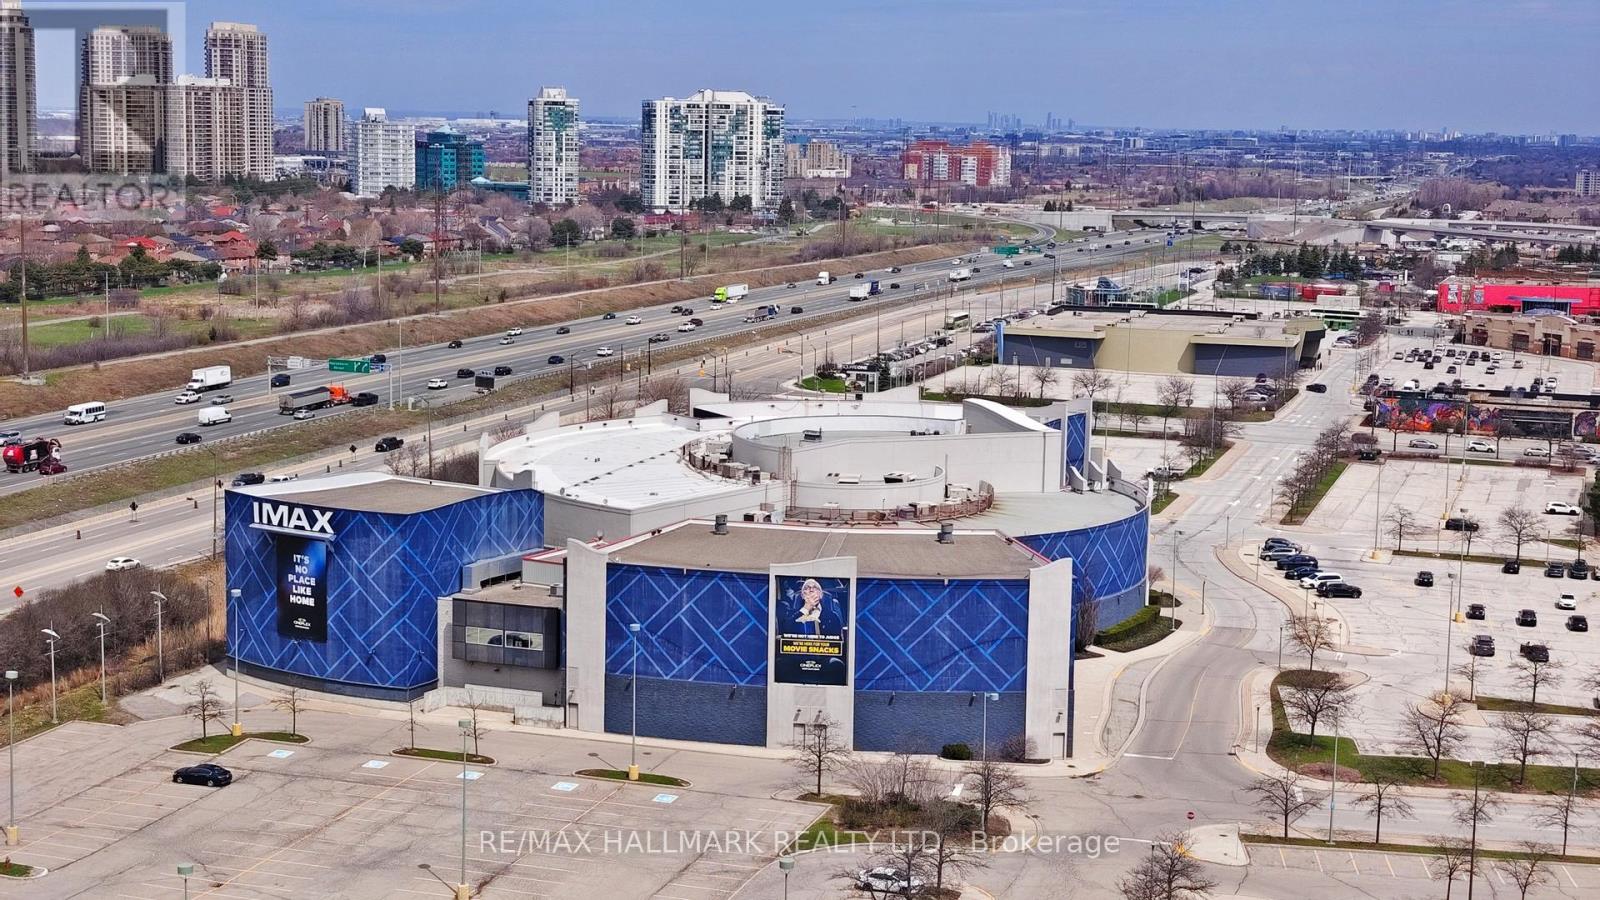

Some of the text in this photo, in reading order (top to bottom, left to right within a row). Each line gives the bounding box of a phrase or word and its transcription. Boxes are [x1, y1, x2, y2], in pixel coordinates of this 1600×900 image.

[252, 501, 335, 534] IMAX
[293, 554, 310, 564] IT'S
[295, 565, 308, 574] NO
[288, 574, 316, 586] PLACE
[292, 585, 312, 595] LIKE
[289, 594, 315, 607] HOME
